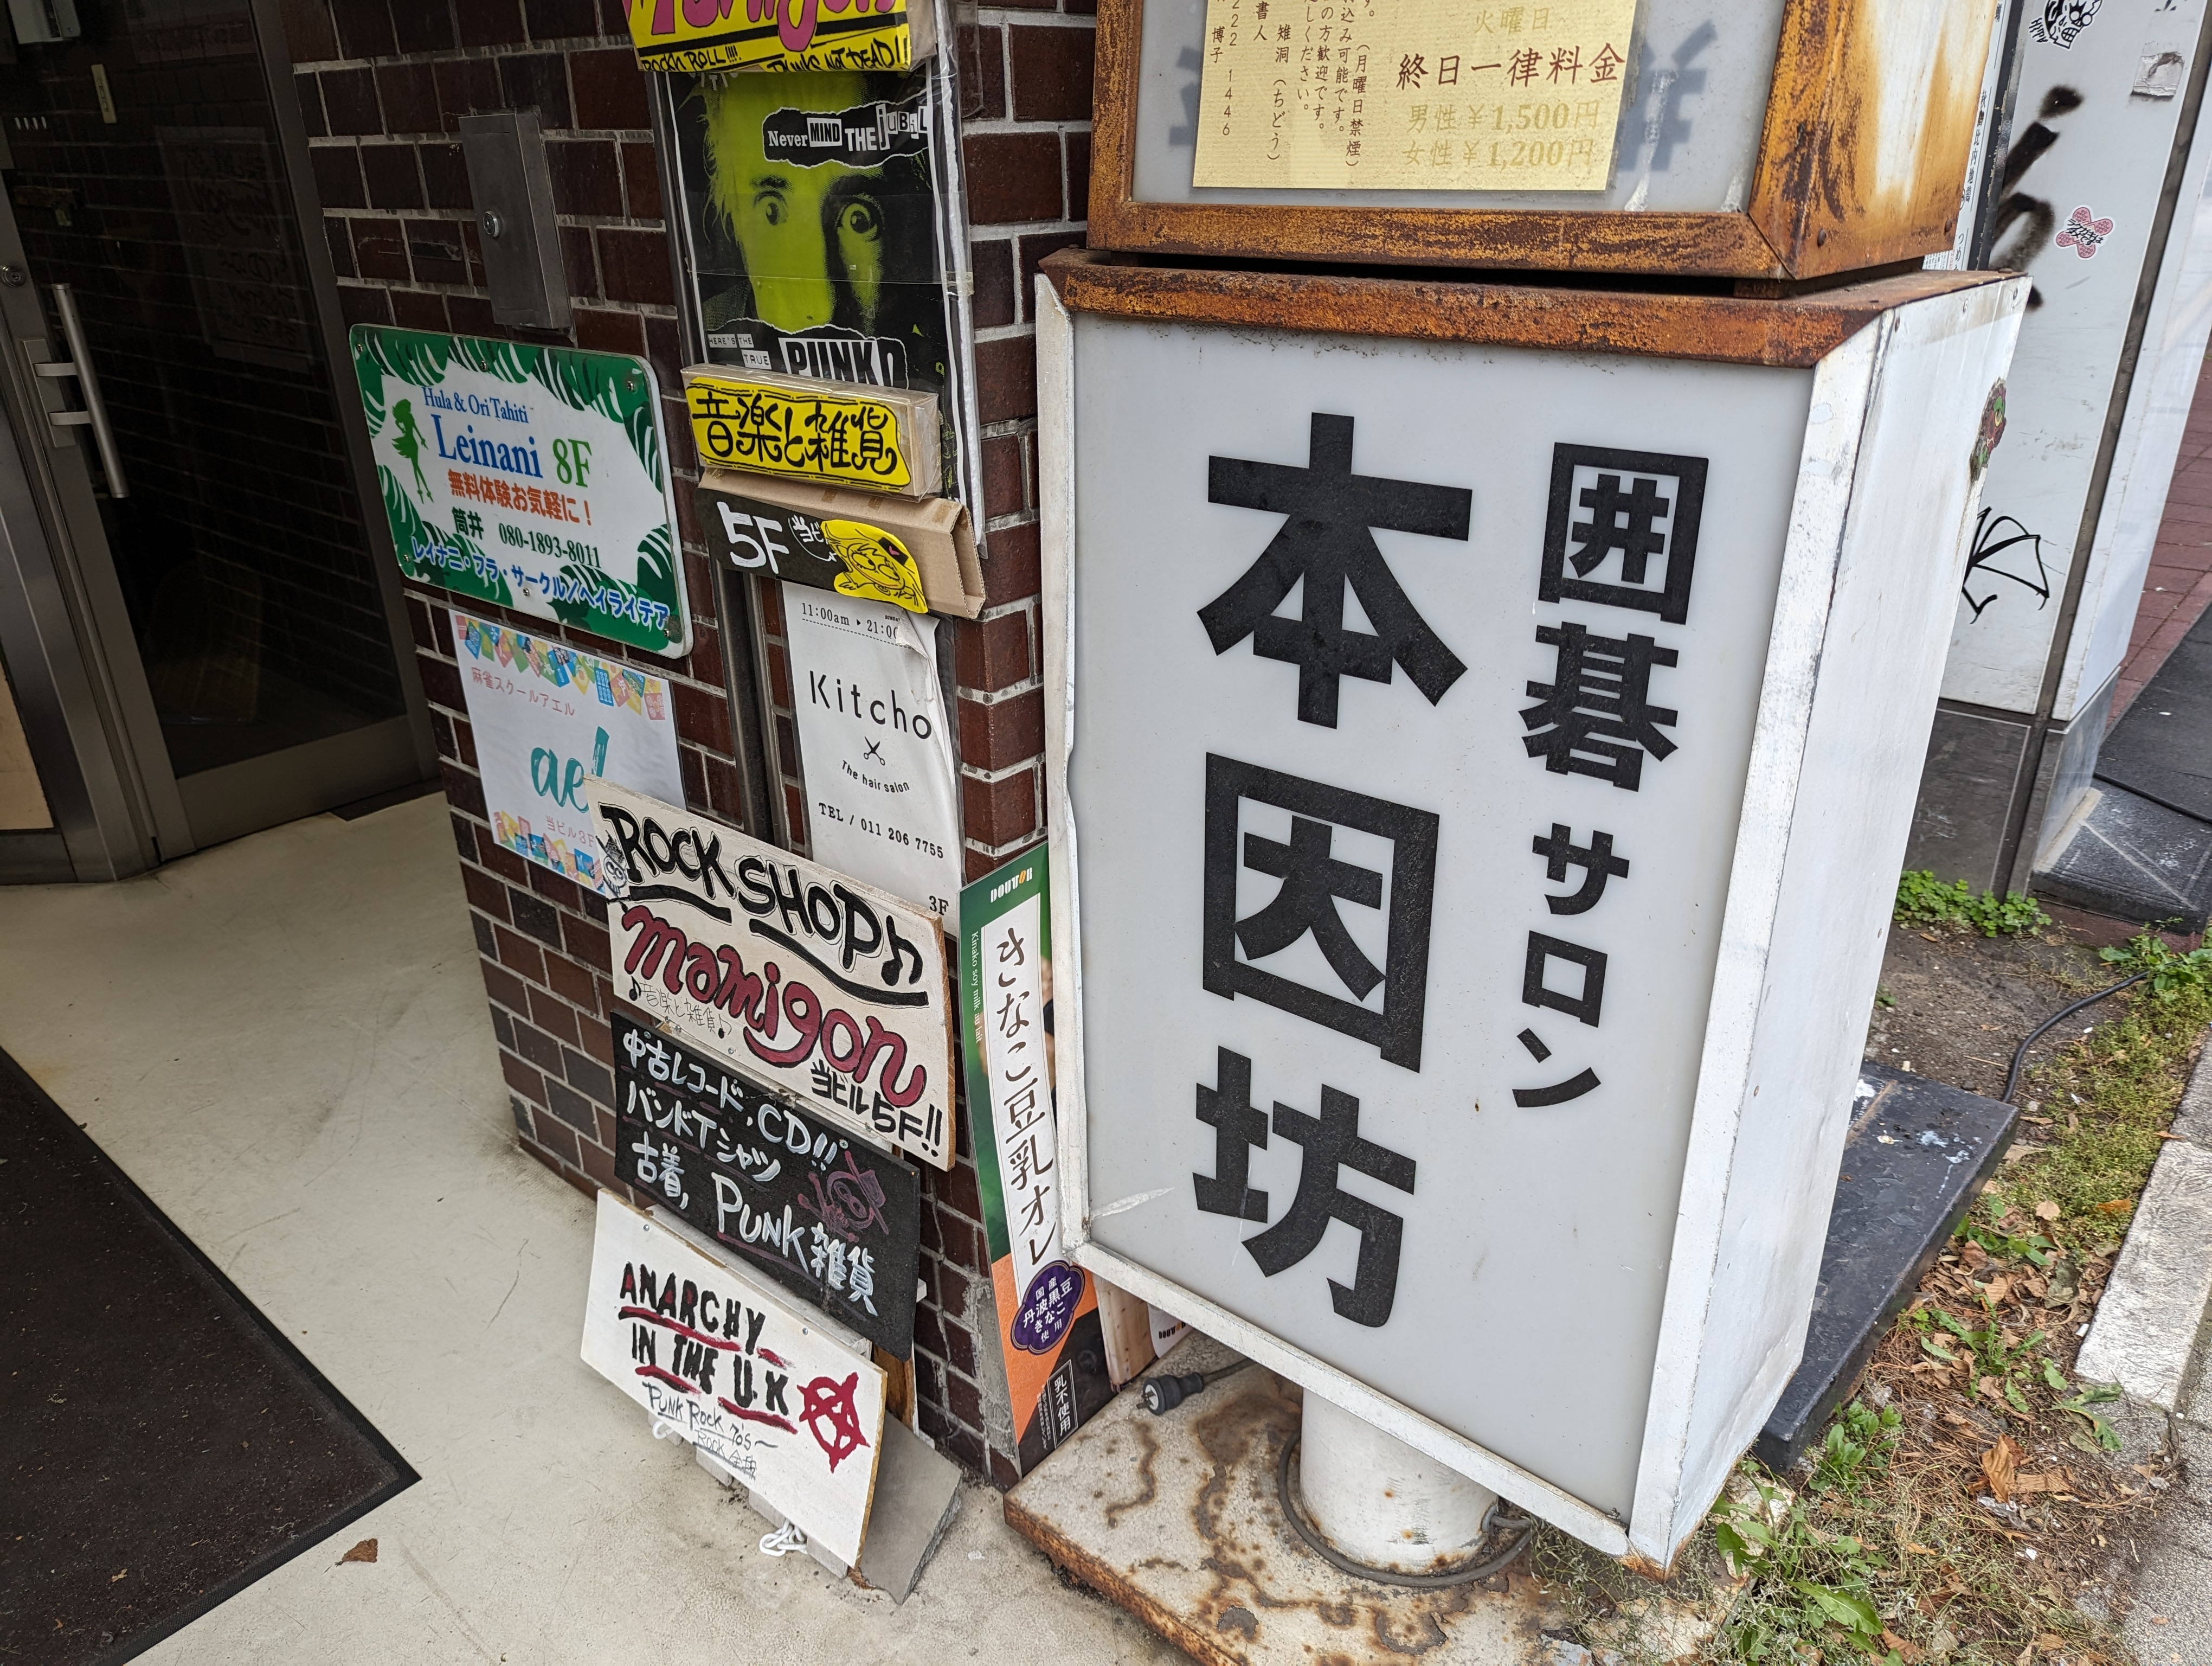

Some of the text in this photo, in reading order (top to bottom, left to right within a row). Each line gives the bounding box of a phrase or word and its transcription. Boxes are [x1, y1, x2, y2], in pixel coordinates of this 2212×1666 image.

[1474, 7, 1550, 35] 火曜日
[1298, 0, 1316, 110] しください。
[1313, 0, 1334, 129] の方歓迎です。
[1333, 0, 1355, 132] 込み可能です。
[1396, 42, 1625, 90] 終日一律料金
[1346, 44, 1370, 166] (月曜日禁煙)
[767, 130, 808, 147] Never
[809, 120, 841, 144] MIND
[845, 127, 877, 152] THE
[708, 335, 754, 348] HERE'S THE
[743, 352, 770, 366] TRUE
[421, 387, 529, 424] Hula & Ori Tahiti
[693, 392, 897, 474] 音楽と雑貨
[430, 414, 592, 488] Leinani 8F
[452, 507, 602, 569] 筒井 080-1893-8011
[716, 501, 790, 574] 5F
[792, 514, 828, 544] 当ビ
[802, 603, 850, 626] 11:00am
[472, 667, 575, 716] 麻雀スクールアエル
[809, 670, 932, 739] Kitcho
[842, 760, 910, 793] The hair salon
[546, 815, 594, 848] 当ビル3F
[819, 803, 844, 822] TEL
[861, 818, 882, 836] 011
[889, 828, 909, 846] 206
[915, 837, 944, 859] 7755
[599, 802, 885, 971] ROCK SHOP
[990, 867, 1033, 904] DOUTOR
[1193, 412, 1473, 1328] 本因坊
[929, 895, 949, 915] 3F
[970, 931, 979, 967] Kinako
[975, 1013, 980, 1024] au
[622, 905, 928, 1108] mamigon
[996, 927, 1056, 1266] きなこ豆乳オレ
[620, 1261, 766, 1356] ANARCHY
[1023, 1277, 1073, 1328] 丹波黒豆
[1036, 1276, 1057, 1300] 国産
[1034, 1301, 1066, 1334] きなこ
[1041, 1318, 1062, 1343] 使用
[632, 1323, 656, 1365] IN
[673, 1332, 719, 1395] THE
[1054, 1374, 1071, 1437] 乳不使用
